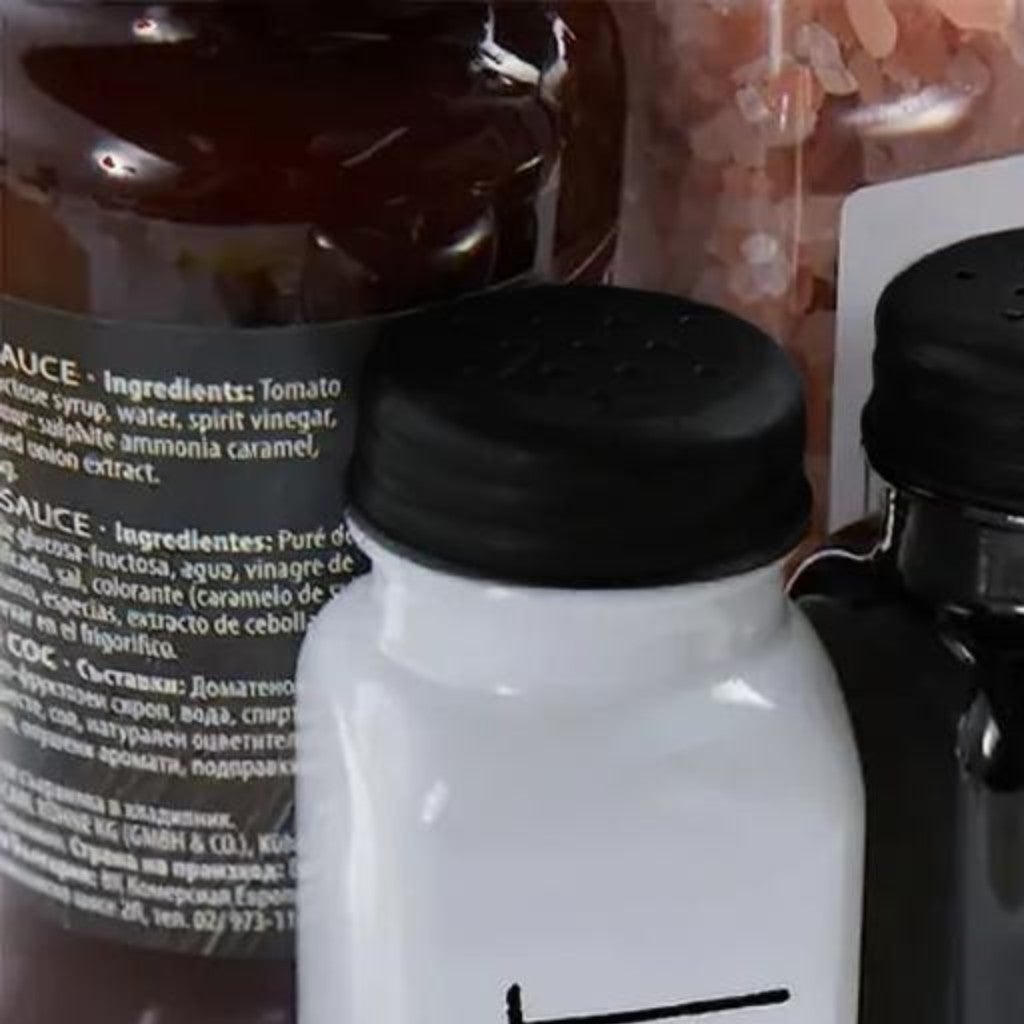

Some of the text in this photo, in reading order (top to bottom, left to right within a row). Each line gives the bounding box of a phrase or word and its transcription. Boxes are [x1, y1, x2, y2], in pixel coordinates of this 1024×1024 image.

[104, 369, 255, 402] Ingredients:
[258, 376, 342, 401] Tomato
[116, 403, 182, 430] water,
[188, 408, 245, 434] spirit
[250, 407, 337, 435] vinegar,
[26, 440, 79, 471] onion
[83, 452, 160, 484] extract.
[119, 433, 221, 459] ammonia
[227, 433, 319, 460] caramel,
[0, 487, 92, 538] SAUCE
[115, 520, 273, 552] Ingredientes:
[278, 526, 326, 551] Puré
[181, 561, 239, 583] agua,
[245, 558, 324, 583] vinagre
[328, 552, 354, 573] de
[93, 576, 184, 606] colorante
[189, 582, 293, 610] (caramelo
[298, 582, 323, 604] de
[127, 609, 209, 635] extracto
[214, 613, 240, 635] de
[245, 611, 309, 635] ceboll
[76, 657, 187, 695] Съставки:
[180, 704, 238, 727] вода,
[86, 718, 187, 748] натурален
